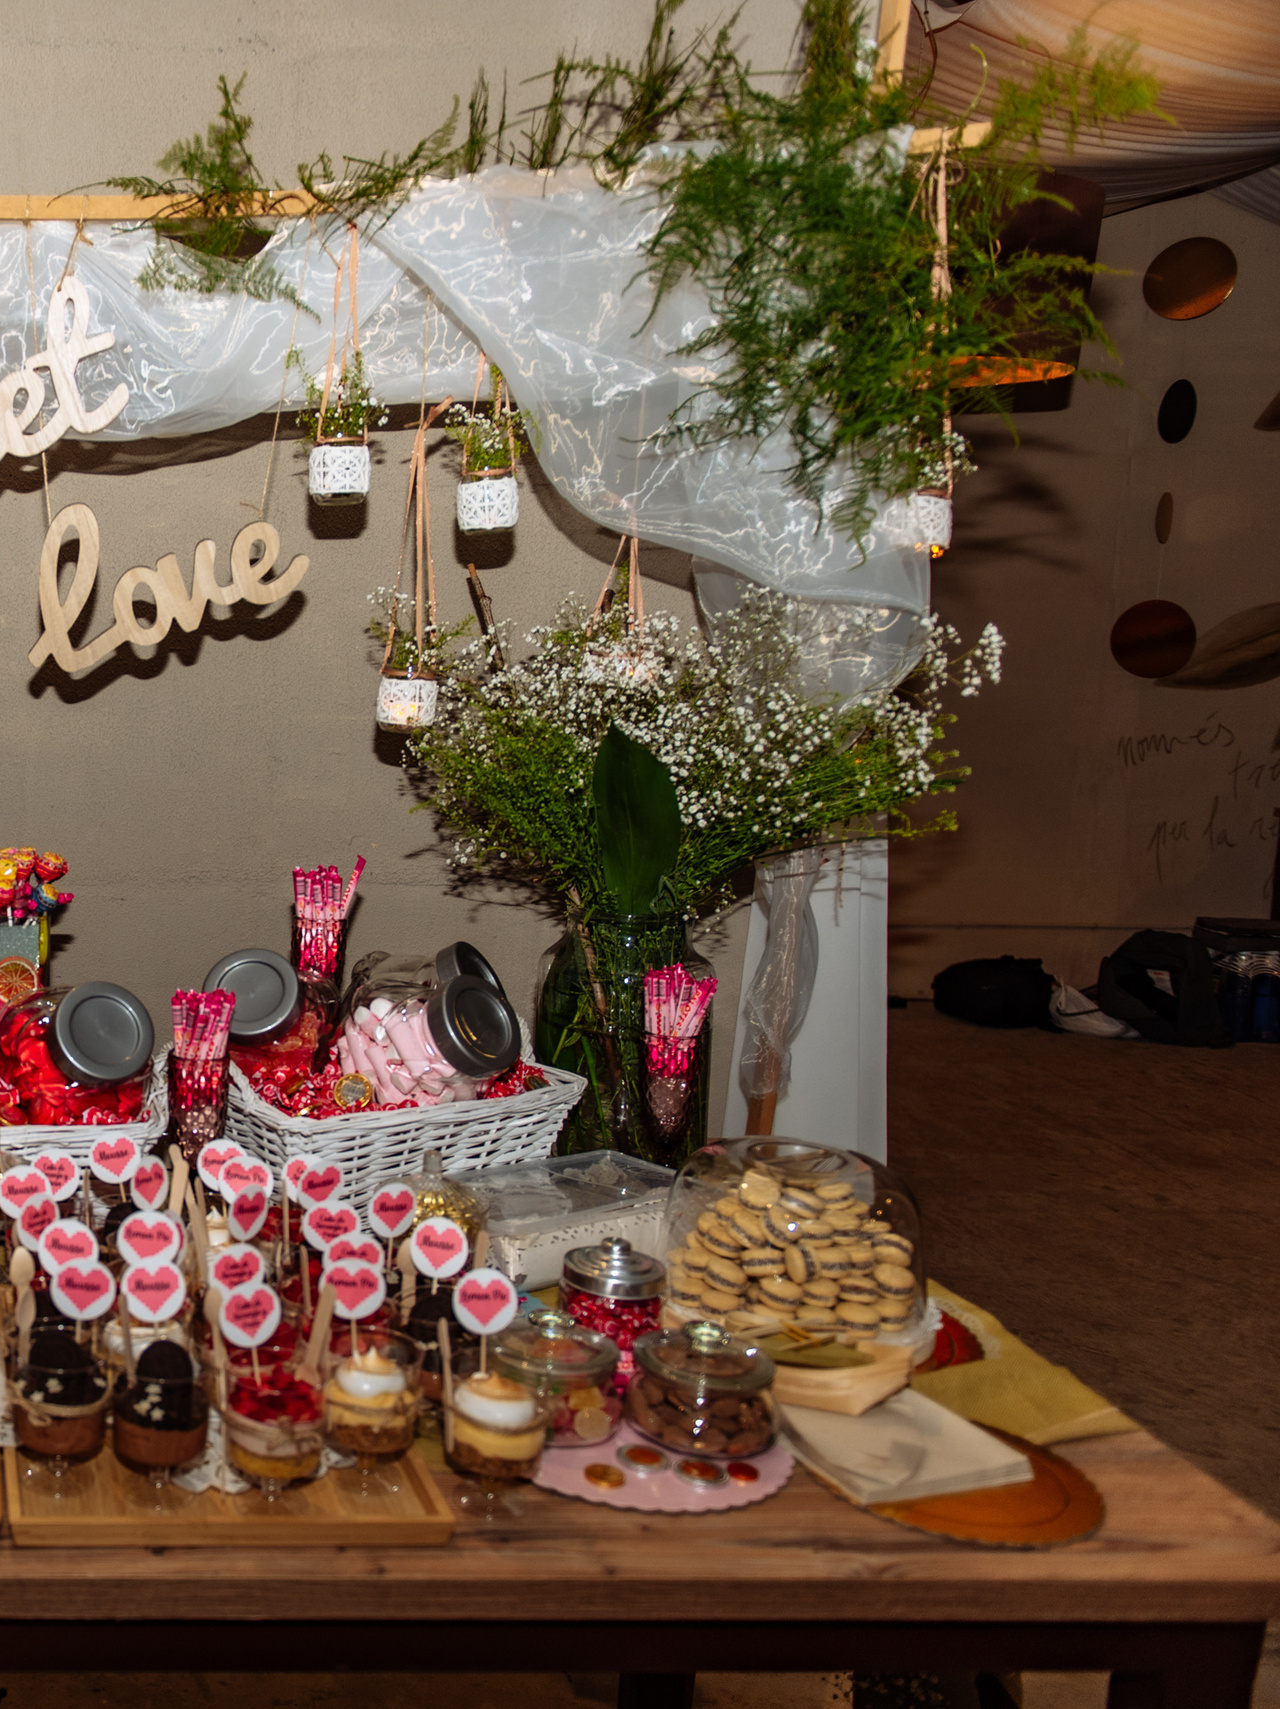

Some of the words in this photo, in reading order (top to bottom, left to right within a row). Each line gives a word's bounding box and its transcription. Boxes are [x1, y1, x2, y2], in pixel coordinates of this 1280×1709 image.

[28, 503, 310, 673] love
[1202, 796, 1235, 850] la
[675, 988, 702, 1028] PALOTES
[98, 1150, 128, 1160] Mousse
[6, 1185, 38, 1196] Mousse
[421, 1236, 455, 1250] Mousse
